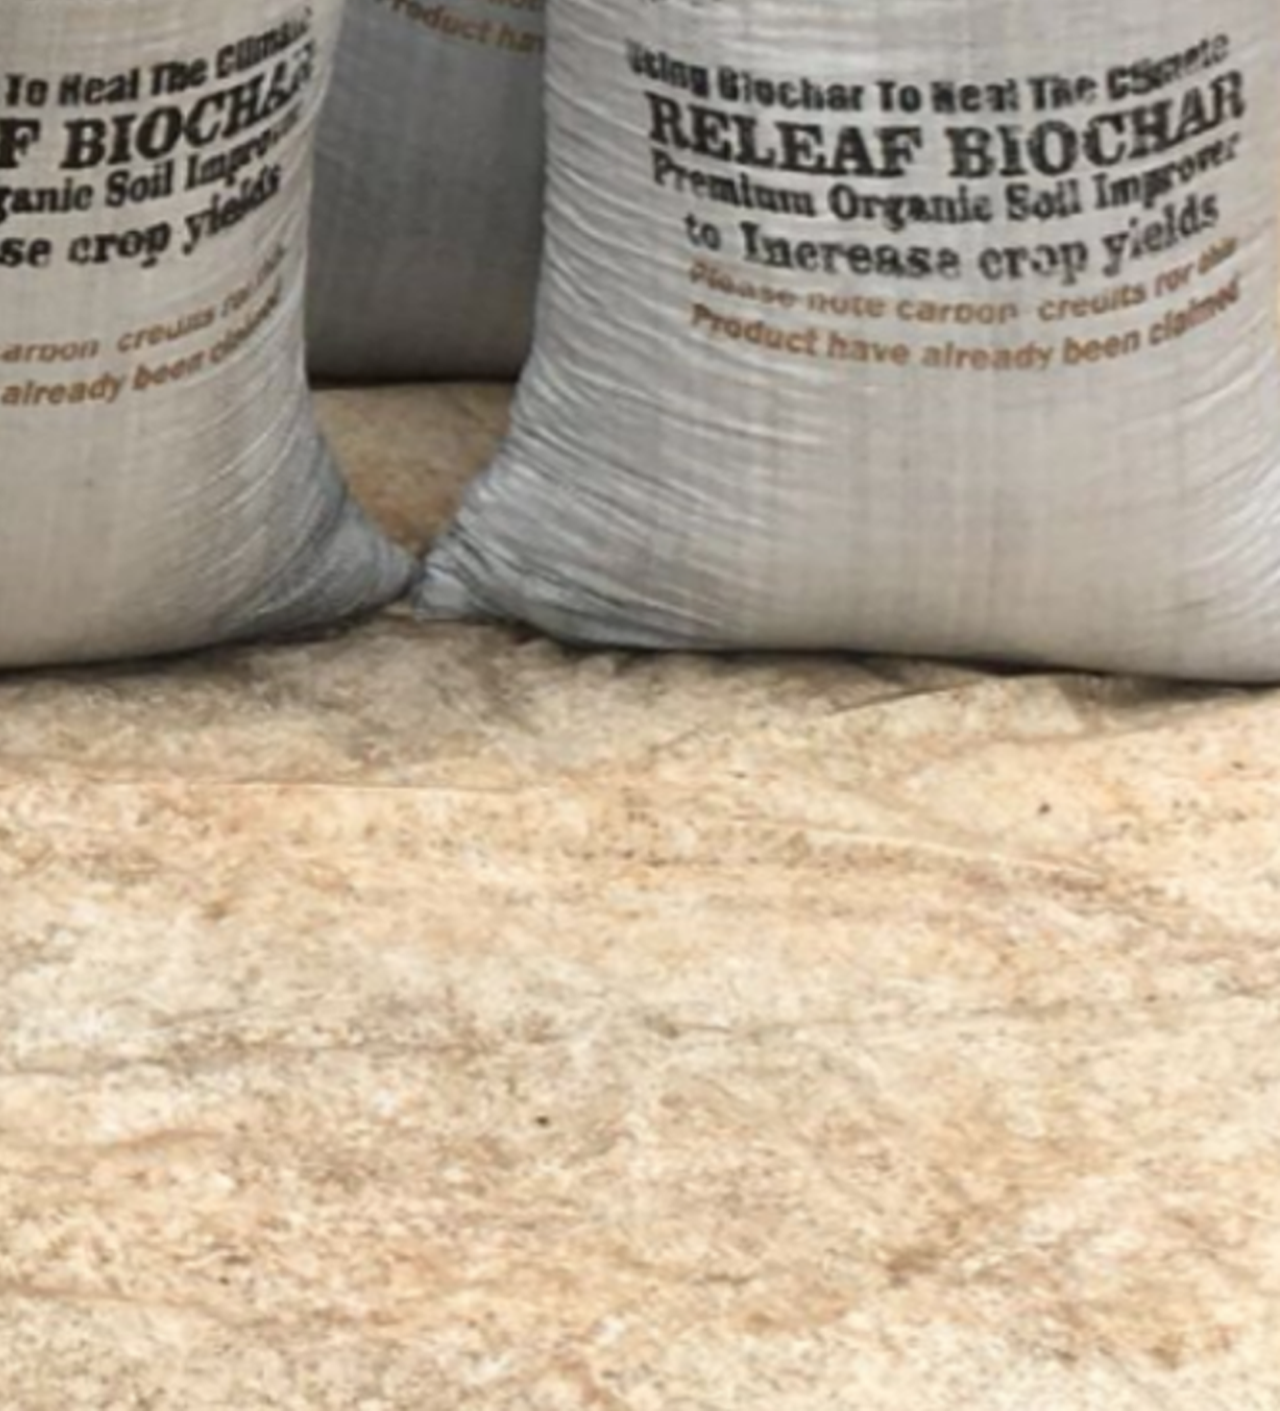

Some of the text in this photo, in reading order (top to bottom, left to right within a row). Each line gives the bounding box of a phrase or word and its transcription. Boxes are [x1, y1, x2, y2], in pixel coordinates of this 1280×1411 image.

[5, 73, 49, 107] To
[58, 68, 140, 107] Heal
[148, 58, 208, 97] The
[717, 66, 864, 111] Biochar
[876, 80, 923, 112] To
[930, 78, 1020, 114] Heal
[1027, 74, 1097, 110] The
[645, 70, 1245, 179] RELEAF BIOCHAR
[104, 159, 175, 209] Soil
[651, 131, 1242, 232] Premium Organic Soil Improver
[67, 222, 171, 269] crop
[685, 193, 1220, 286] to Increase crop yields
[690, 275, 1241, 373] Product have already been claimed
[1, 373, 124, 409] already
